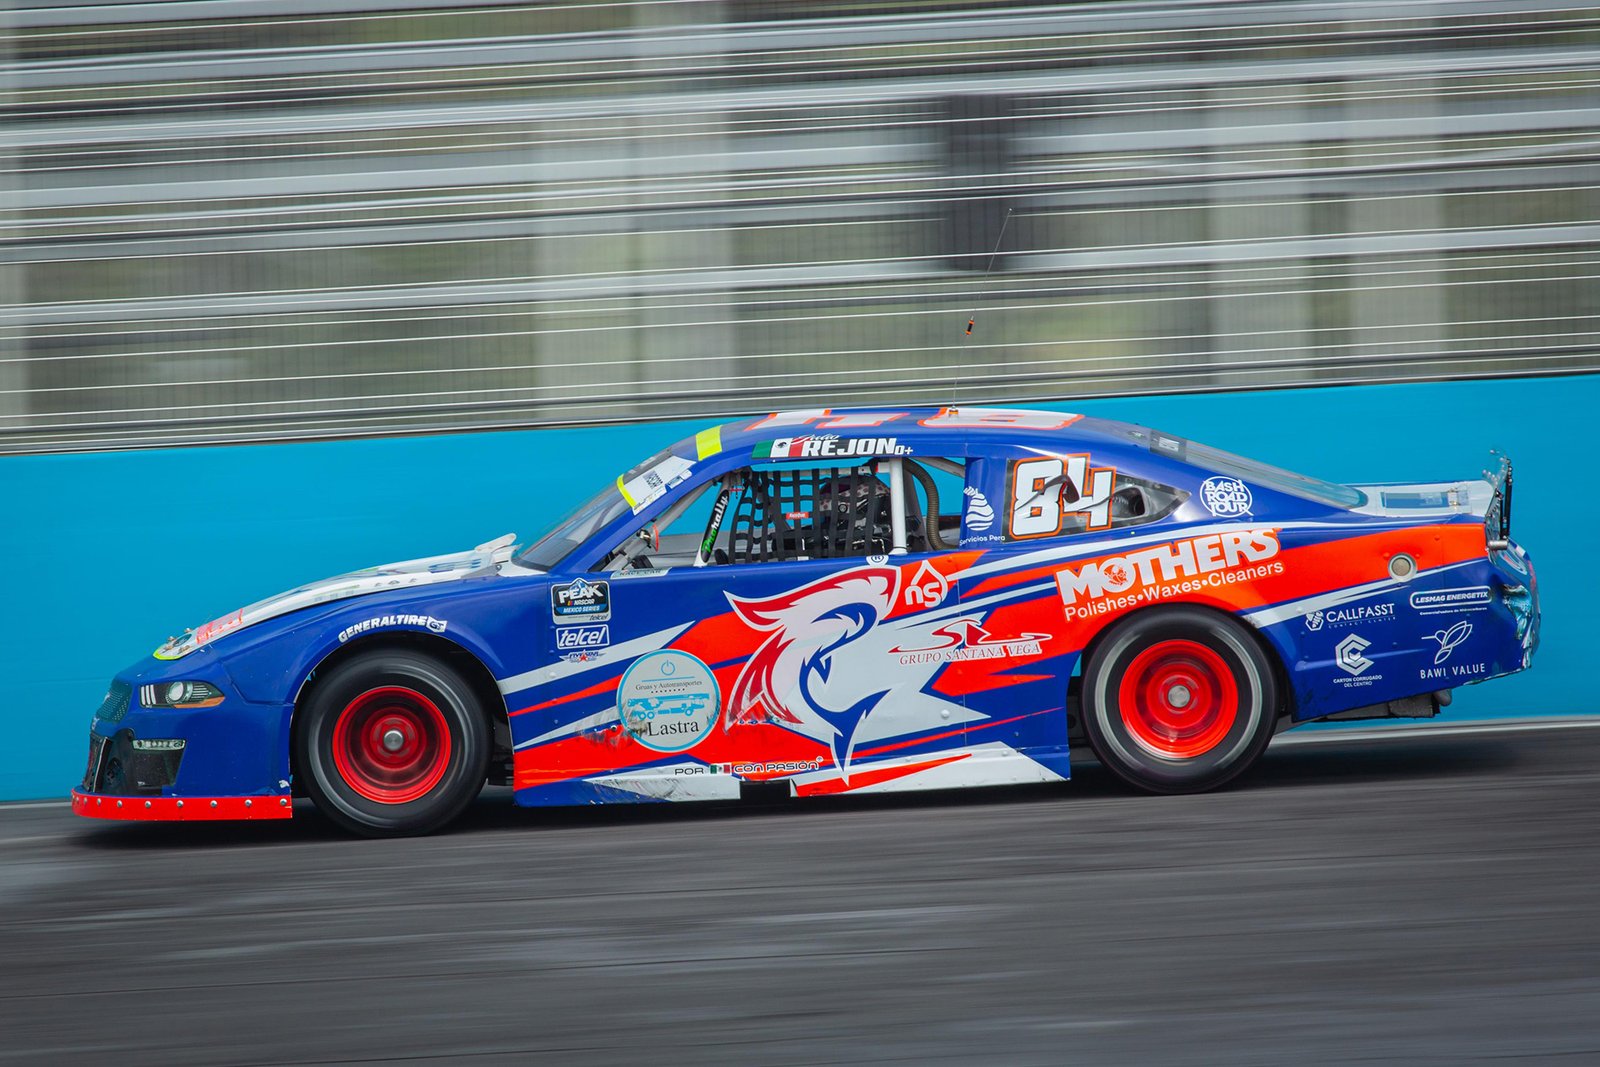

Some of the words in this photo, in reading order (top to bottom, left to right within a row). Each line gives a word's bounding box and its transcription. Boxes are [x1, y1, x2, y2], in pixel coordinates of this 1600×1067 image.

[801, 438, 897, 456] REJON
[1203, 480, 1245, 492] BASH
[1009, 453, 1116, 540] 84
[1205, 491, 1248, 502] ROAD
[1208, 501, 1254, 517] TOUR
[1056, 529, 1279, 606] MOTHERS
[558, 584, 604, 604] PEAK
[1064, 594, 1137, 621] Polishes
[1143, 578, 1202, 601] Waxes
[1208, 562, 1284, 587] Cleaners
[1415, 595, 1445, 604] LESMAG
[1446, 591, 1488, 600] ENERGETIX
[1326, 603, 1395, 622] CALLFASST
[559, 627, 606, 647] telcel
[900, 652, 941, 665] GRUPO
[945, 648, 1005, 662] SANTANA
[1007, 643, 1041, 656] VEGA
[1420, 668, 1447, 679] BAWI
[1452, 663, 1485, 675] VALUE
[647, 720, 700, 737] Lastra
[674, 767, 704, 775] POR
